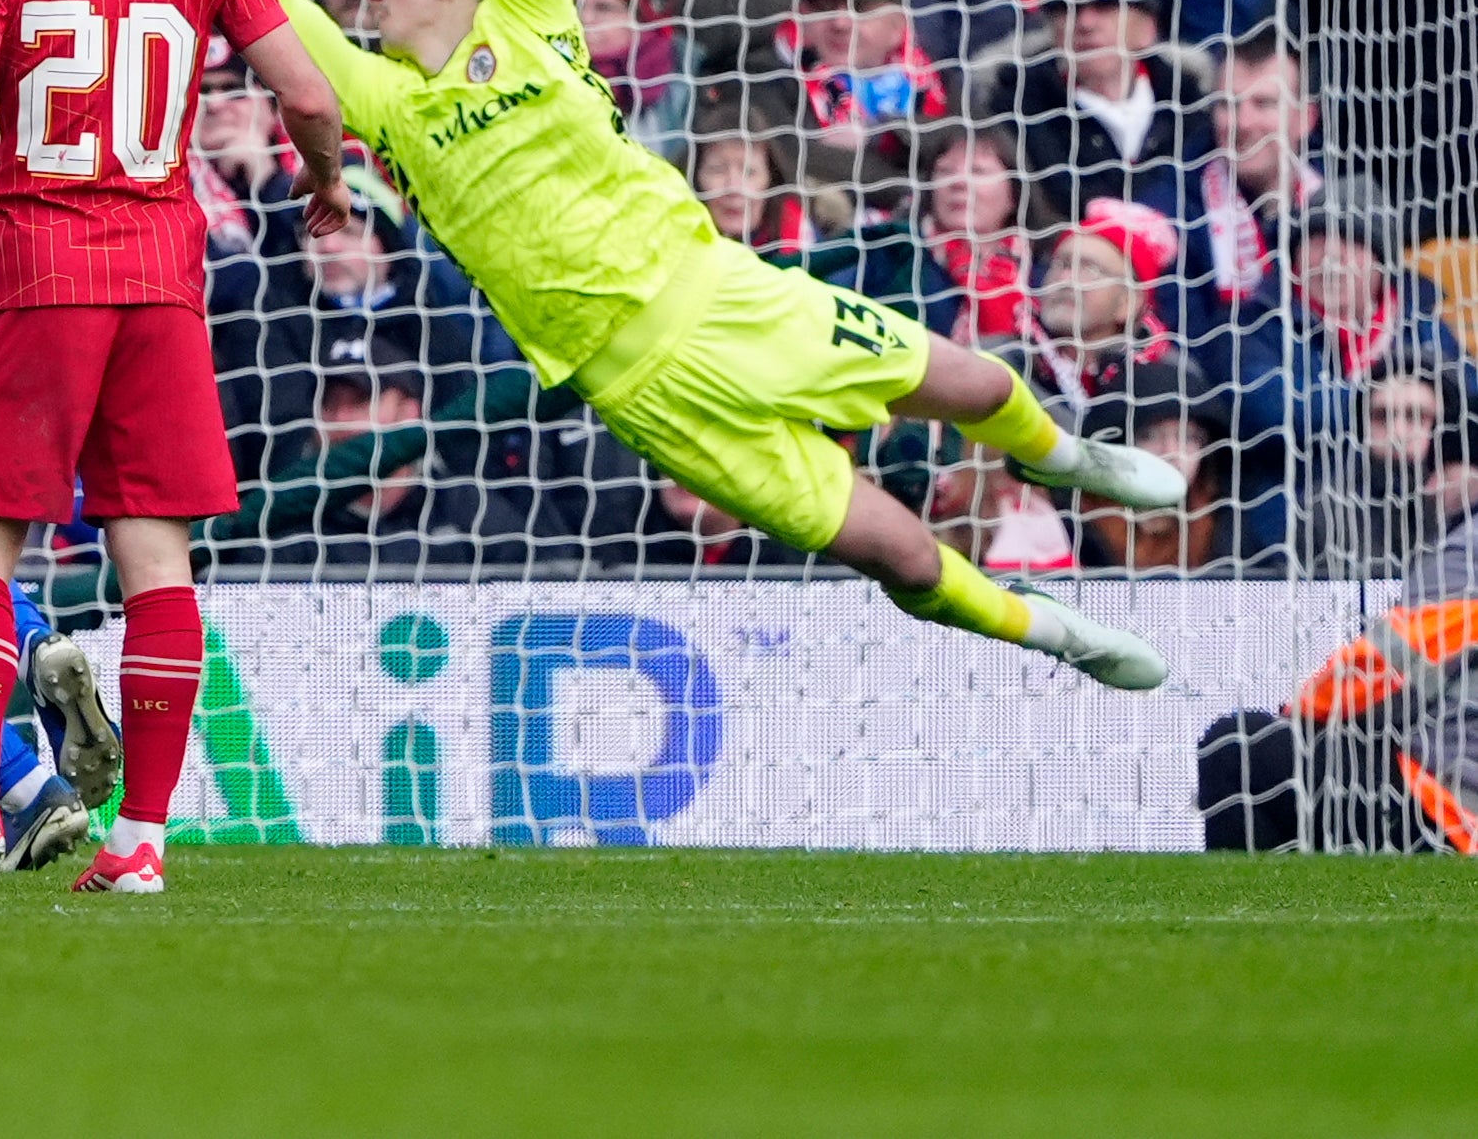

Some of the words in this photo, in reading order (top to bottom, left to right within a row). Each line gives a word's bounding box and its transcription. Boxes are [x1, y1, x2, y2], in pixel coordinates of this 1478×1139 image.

[15, 0, 198, 181] 20
[430, 82, 542, 149] wham
[832, 296, 885, 357] 13
[133, 699, 169, 711] LFC
